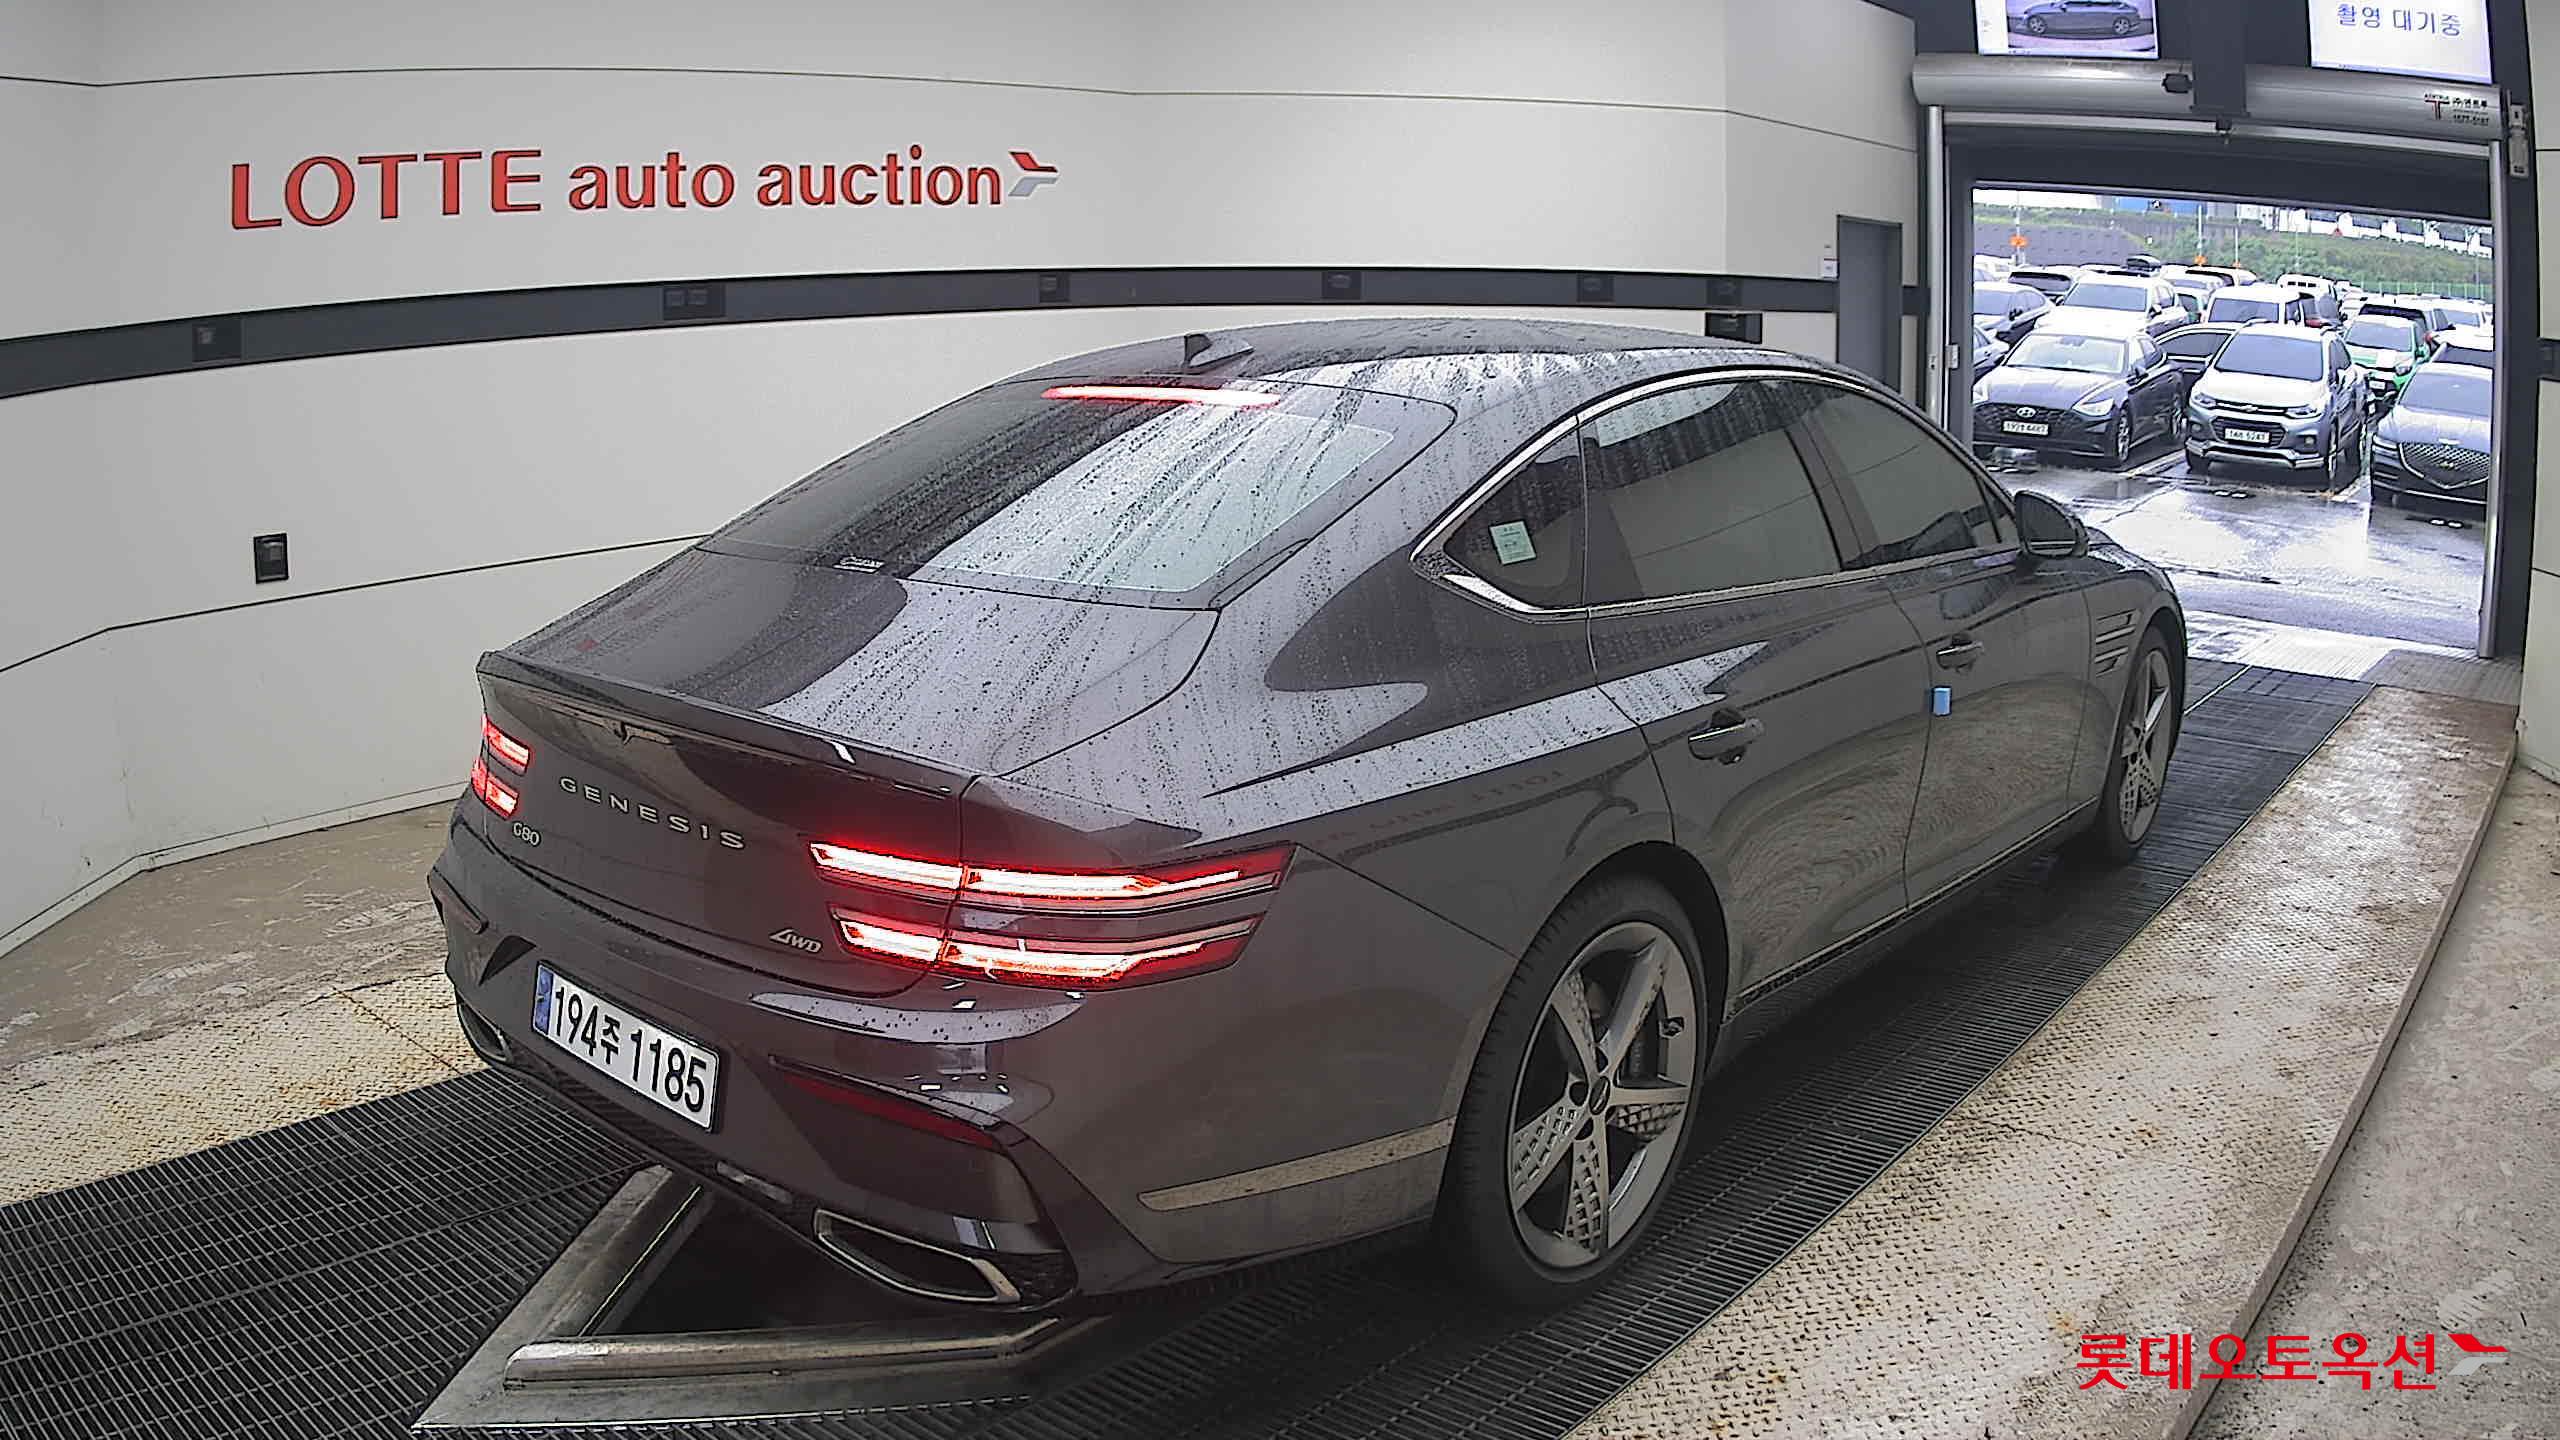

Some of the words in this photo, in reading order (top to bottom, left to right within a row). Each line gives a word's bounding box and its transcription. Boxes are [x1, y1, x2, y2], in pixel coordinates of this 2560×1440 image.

[2392, 9, 2460, 36] 대기중
[232, 150, 541, 230] LOTTE
[568, 152, 735, 209] auto
[757, 145, 1002, 208] auction
[512, 822, 541, 846] G80
[560, 776, 744, 849] GENESIS
[769, 929, 821, 952] 4WD
[555, 986, 621, 1065] 194주
[630, 1028, 707, 1113] 1185
